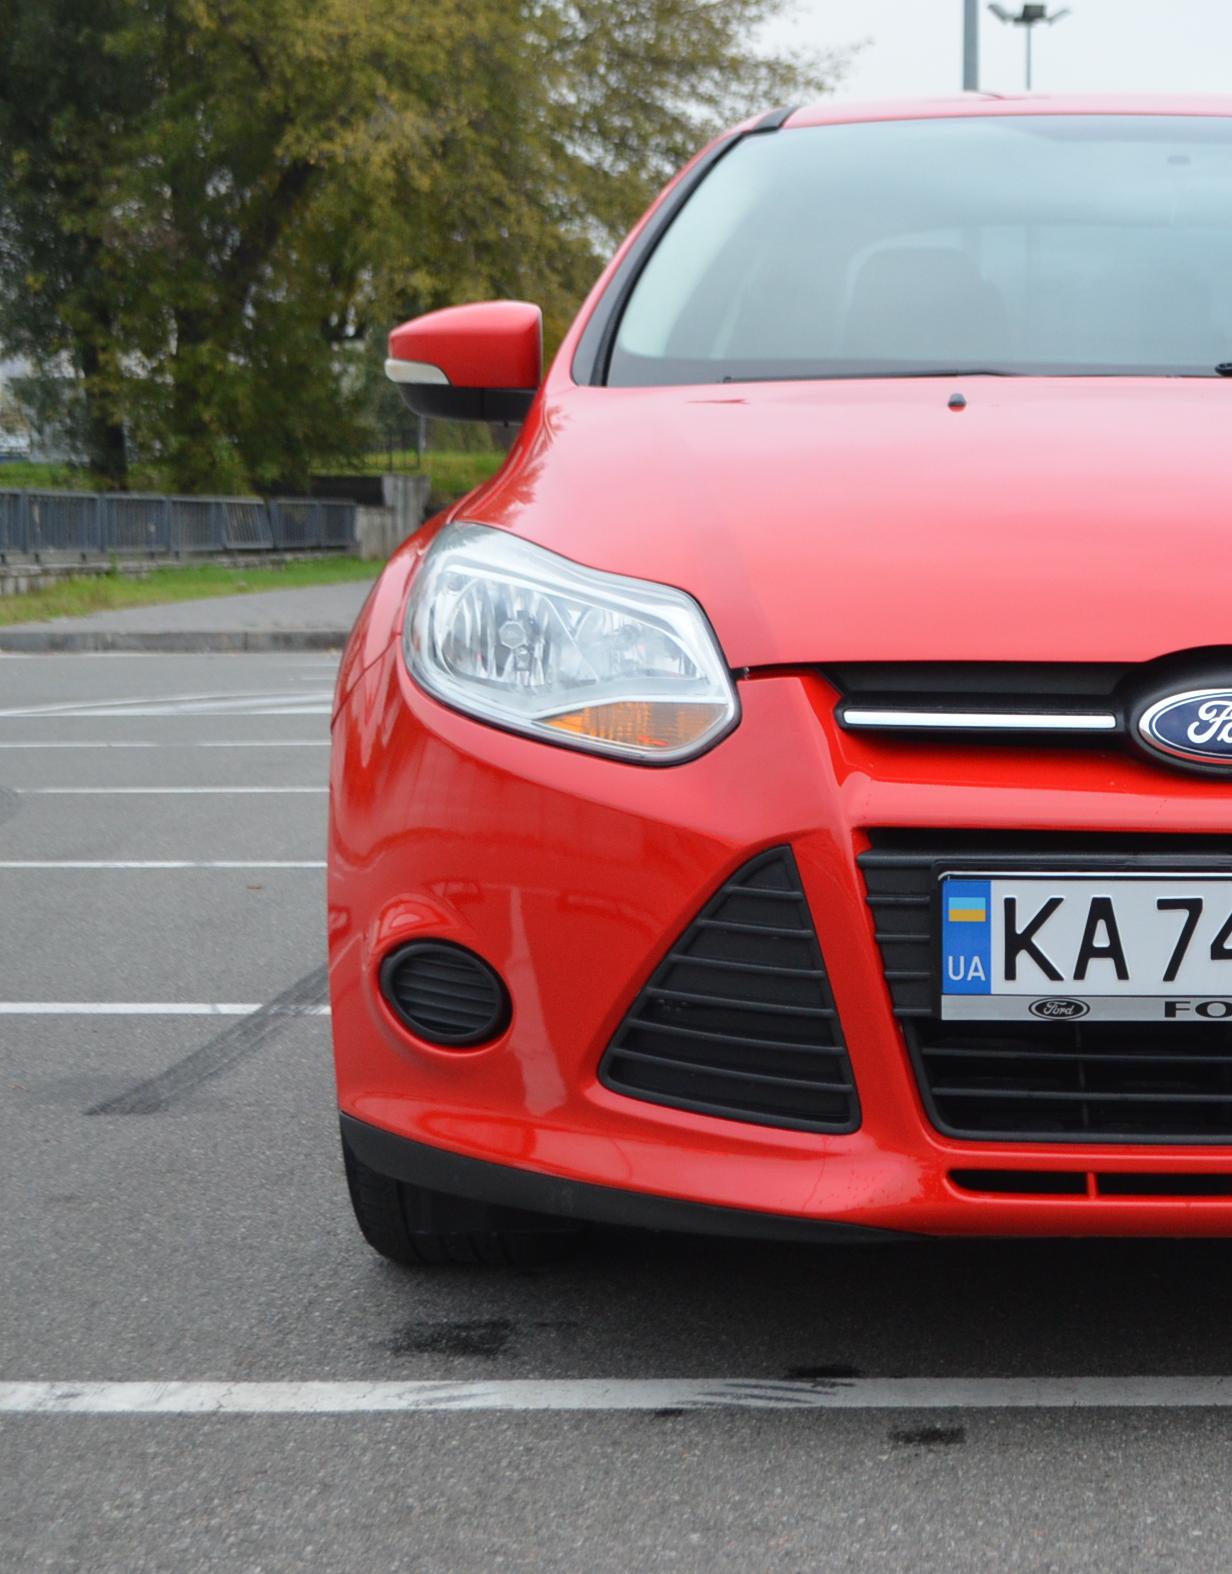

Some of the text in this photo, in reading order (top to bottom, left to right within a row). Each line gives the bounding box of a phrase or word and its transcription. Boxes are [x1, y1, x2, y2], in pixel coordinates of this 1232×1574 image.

[1003, 897, 1130, 981] KA
[948, 955, 986, 981] UA
[1043, 1001, 1074, 1016] Ford
